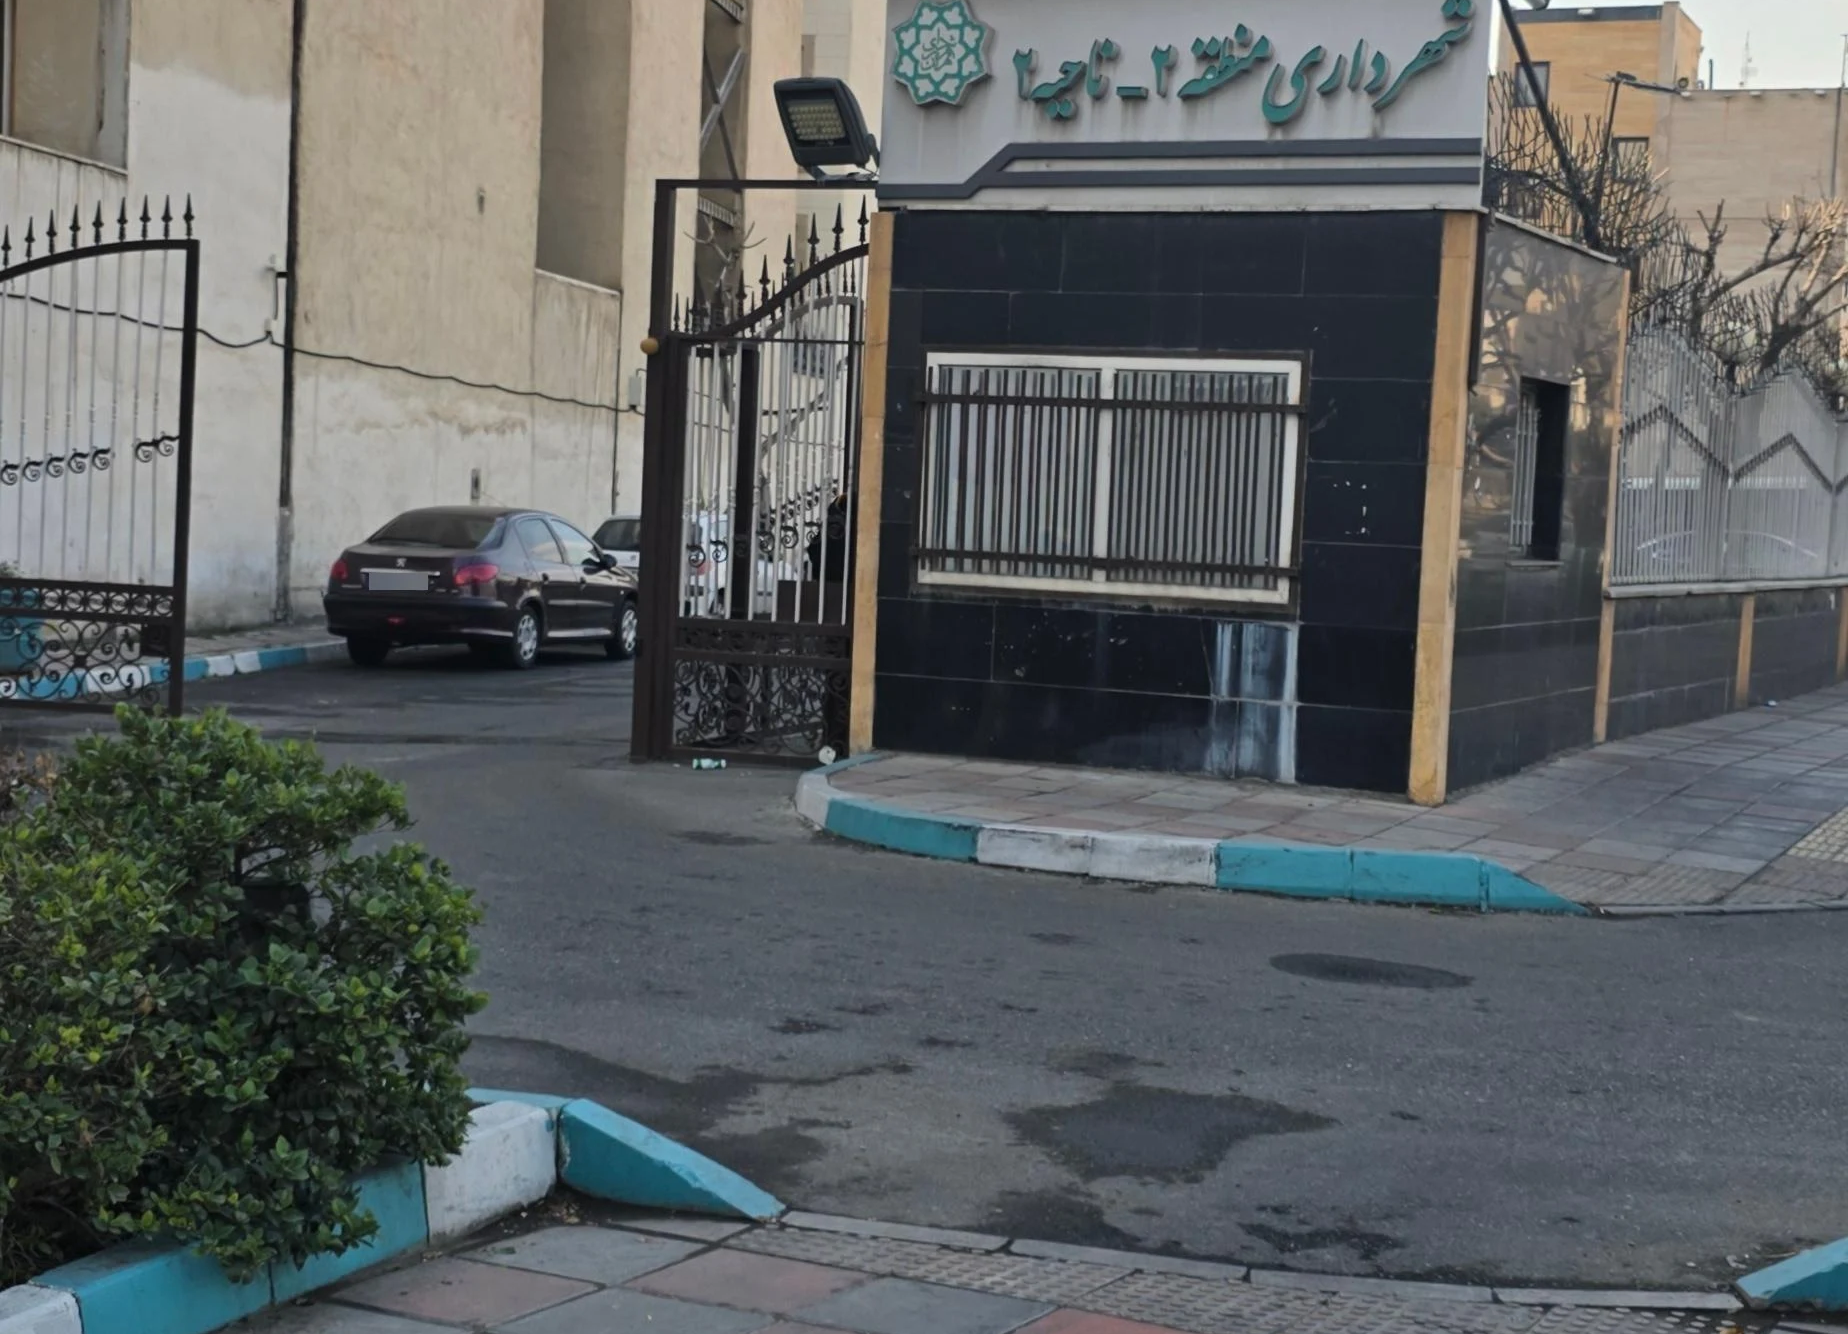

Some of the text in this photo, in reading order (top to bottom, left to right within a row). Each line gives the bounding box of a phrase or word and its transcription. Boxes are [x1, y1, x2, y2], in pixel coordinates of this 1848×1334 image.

[1012, 48, 1038, 100] ۲
[1030, 38, 1120, 119] ناحیه
[1151, 44, 1178, 98] ۲
[1177, 22, 1273, 100] منطقه
